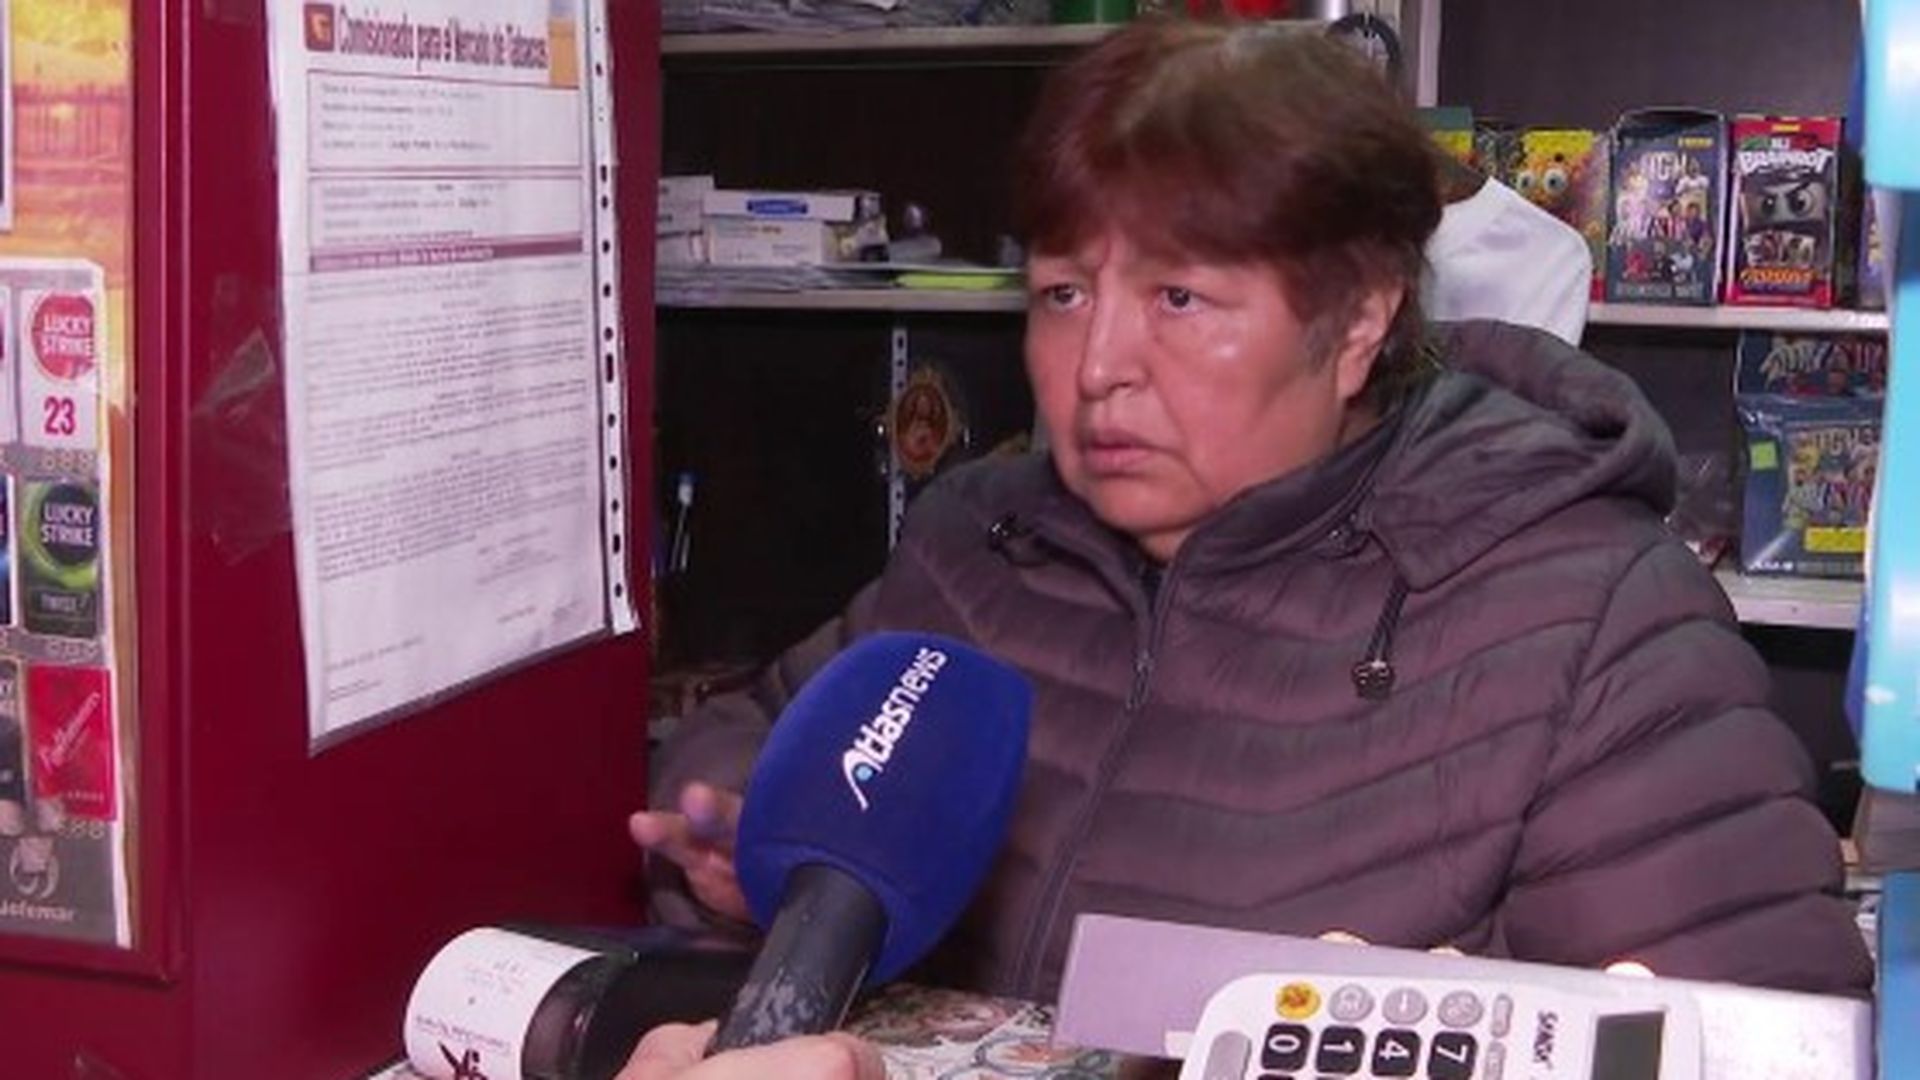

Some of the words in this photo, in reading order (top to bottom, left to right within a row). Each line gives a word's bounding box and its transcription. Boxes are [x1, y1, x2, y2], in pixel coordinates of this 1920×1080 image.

[417, 24, 441, 72] para
[43, 313, 91, 335] LUCKY
[41, 334, 93, 357] STRIKE
[44, 396, 76, 435] 23
[44, 502, 94, 525] LUCKY
[41, 524, 94, 546] STRIKE
[843, 647, 948, 811] Atlasnews
[1269, 1033, 1301, 1054] 0
[1322, 1040, 1356, 1053] 1
[1378, 1039, 1410, 1060] 4
[1436, 1043, 1467, 1064] 7
